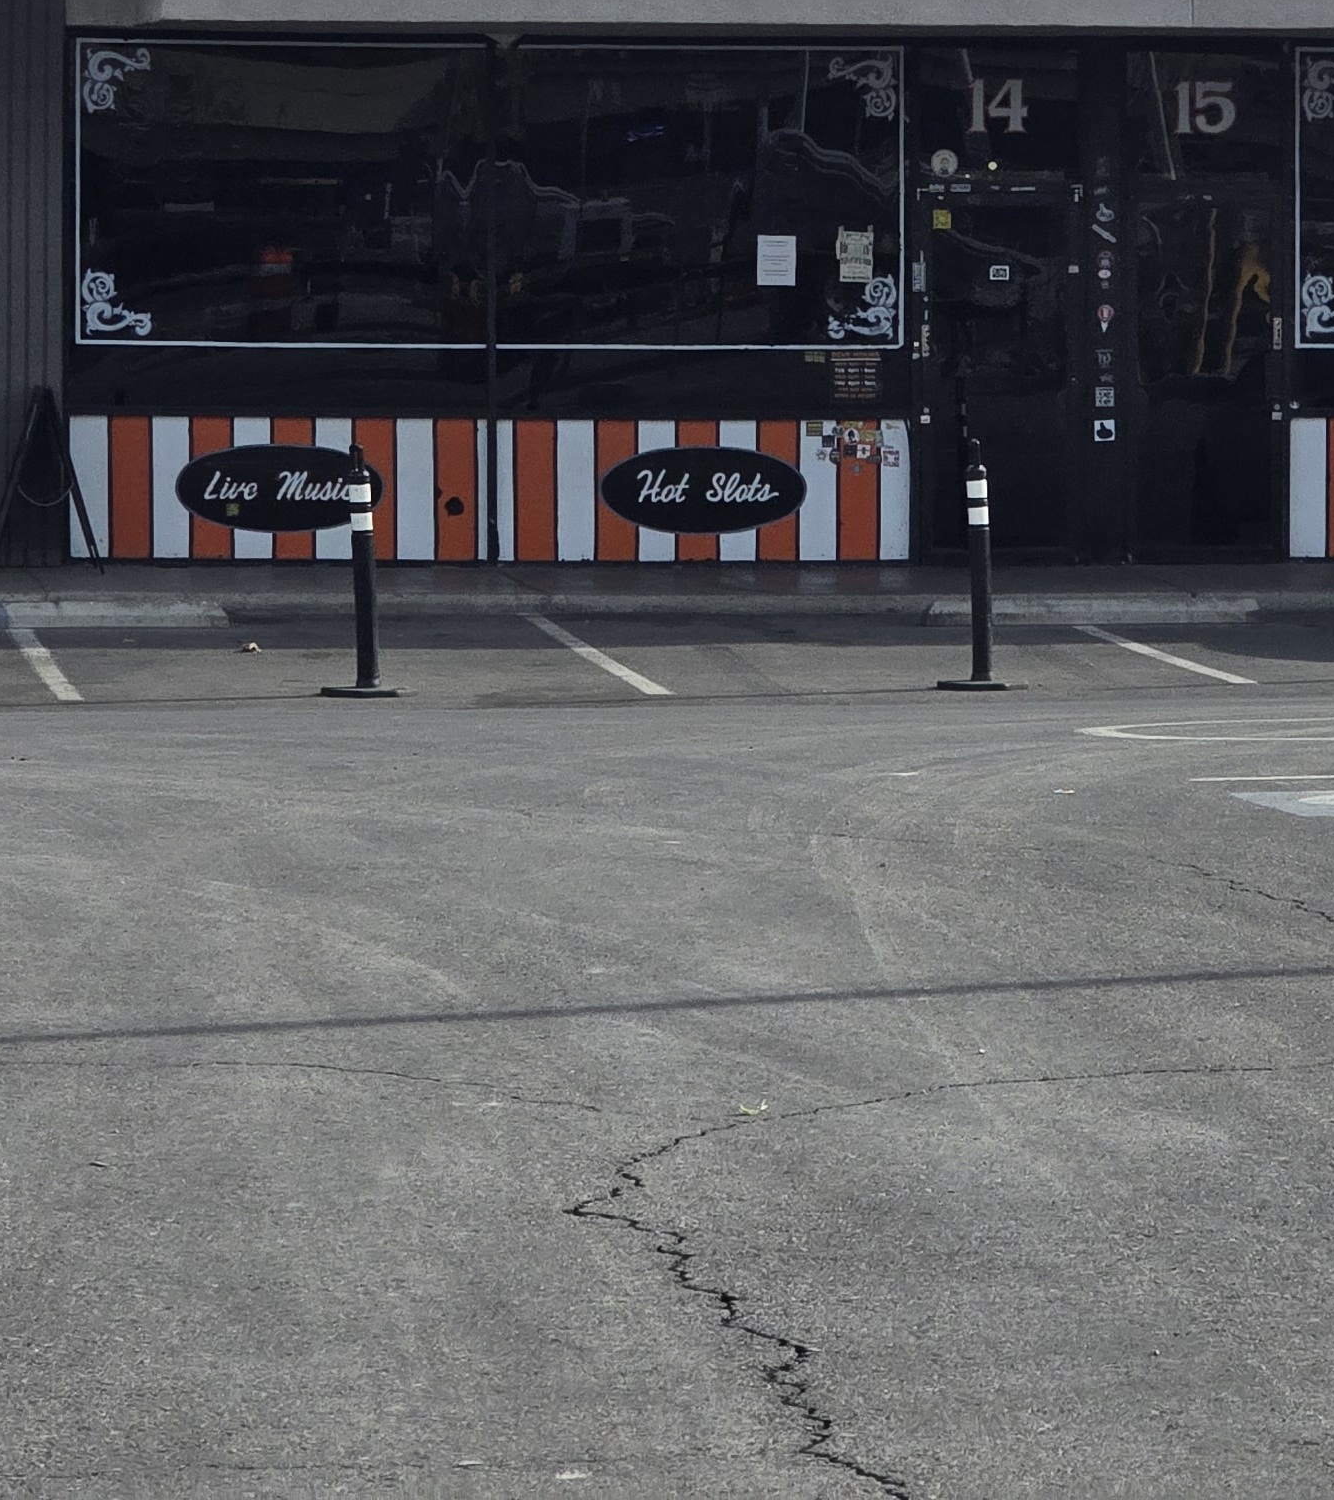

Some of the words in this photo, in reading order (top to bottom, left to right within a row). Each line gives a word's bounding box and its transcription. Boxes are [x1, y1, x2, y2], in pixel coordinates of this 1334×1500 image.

[968, 78, 1029, 134] 14
[1174, 80, 1236, 134] 15
[204, 471, 258, 500] Live
[276, 471, 351, 501] Music
[637, 469, 689, 503] Hot
[706, 472, 779, 503] Slots
